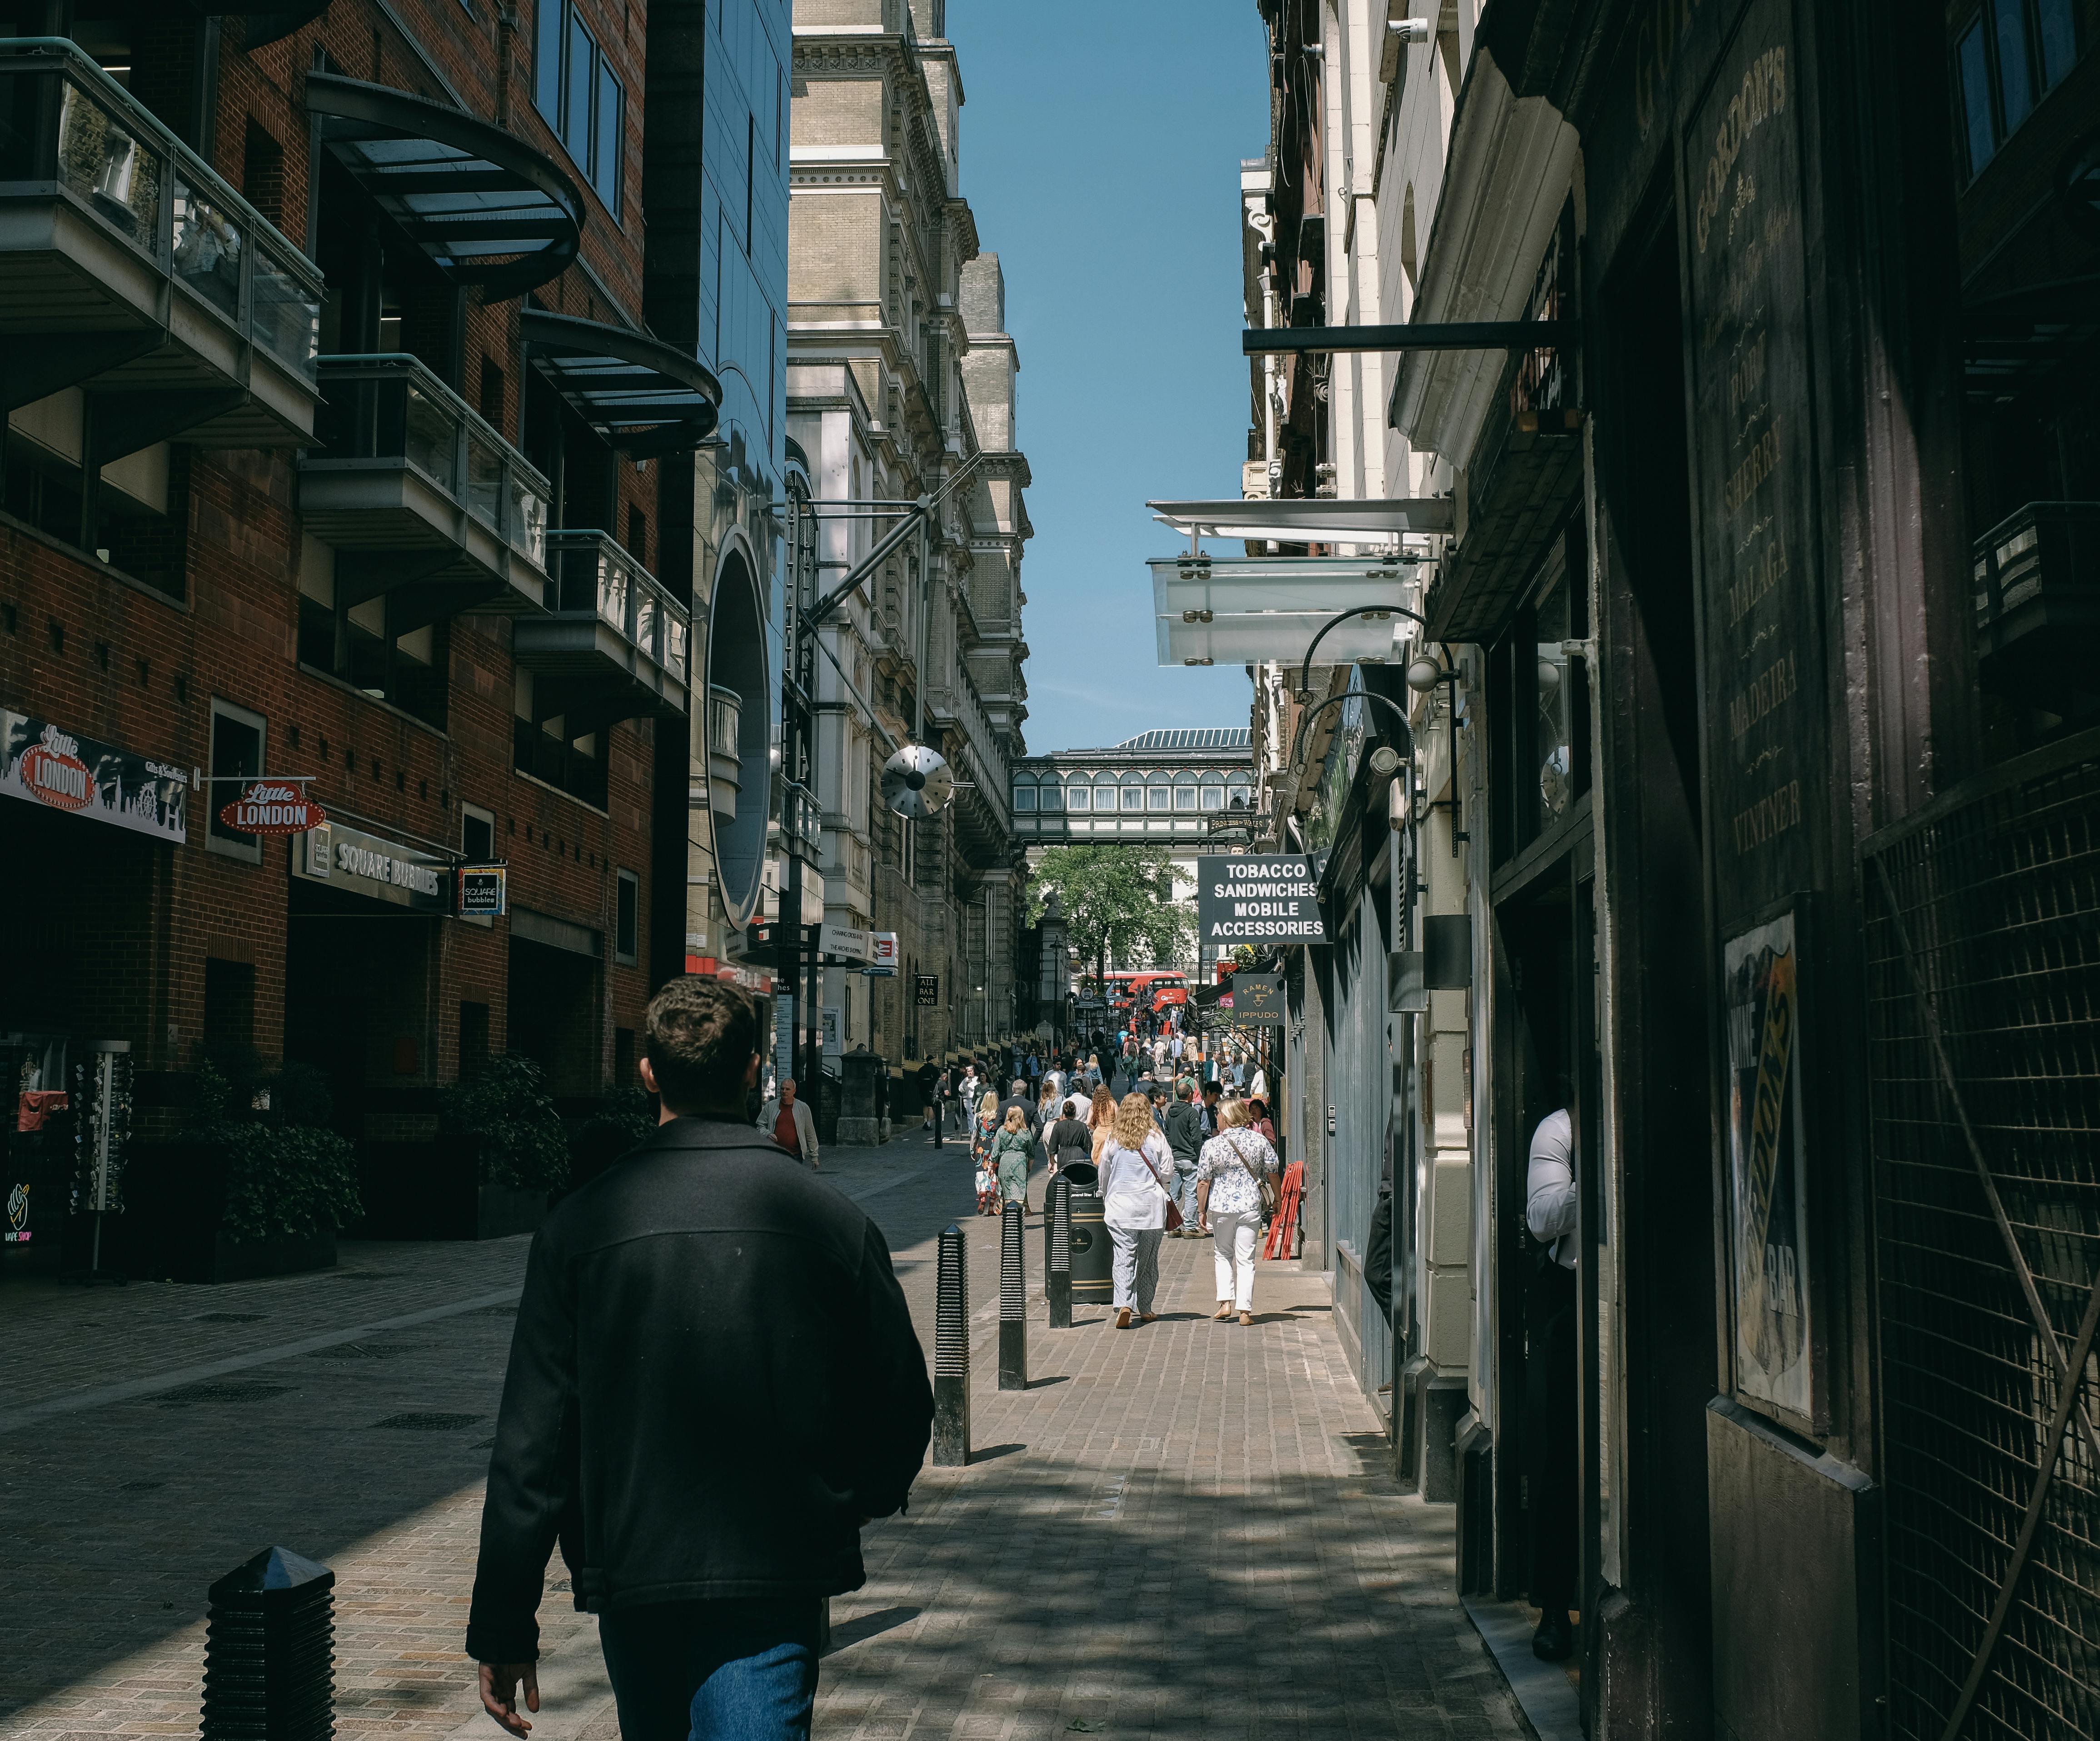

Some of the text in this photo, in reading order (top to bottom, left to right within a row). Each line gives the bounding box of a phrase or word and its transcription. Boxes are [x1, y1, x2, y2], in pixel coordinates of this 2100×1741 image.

[1697, 45, 1786, 253] GORDON'S
[1725, 414, 1781, 509] SHERRY
[1730, 649, 1797, 741] MADEIRA
[40, 724, 78, 759] Little
[34, 755, 86, 800] LONDON
[244, 783, 294, 804] Little
[237, 805, 306, 825] LONDON
[1734, 779, 1801, 856] VINTNER
[338, 843, 438, 896] SQUARE BUBBLES
[1227, 864, 1306, 878] TOBACCO
[1214, 883, 1318, 898] SANDWICHES
[1235, 902, 1298, 916] MOBILE
[1212, 921, 1323, 936] ACCESSORIES
[1243, 984, 1273, 995] RAMEN
[1731, 1002, 1757, 1069] WINE
[18, 1231, 31, 1242] SHOP
[1767, 1243, 1798, 1317] BAR
